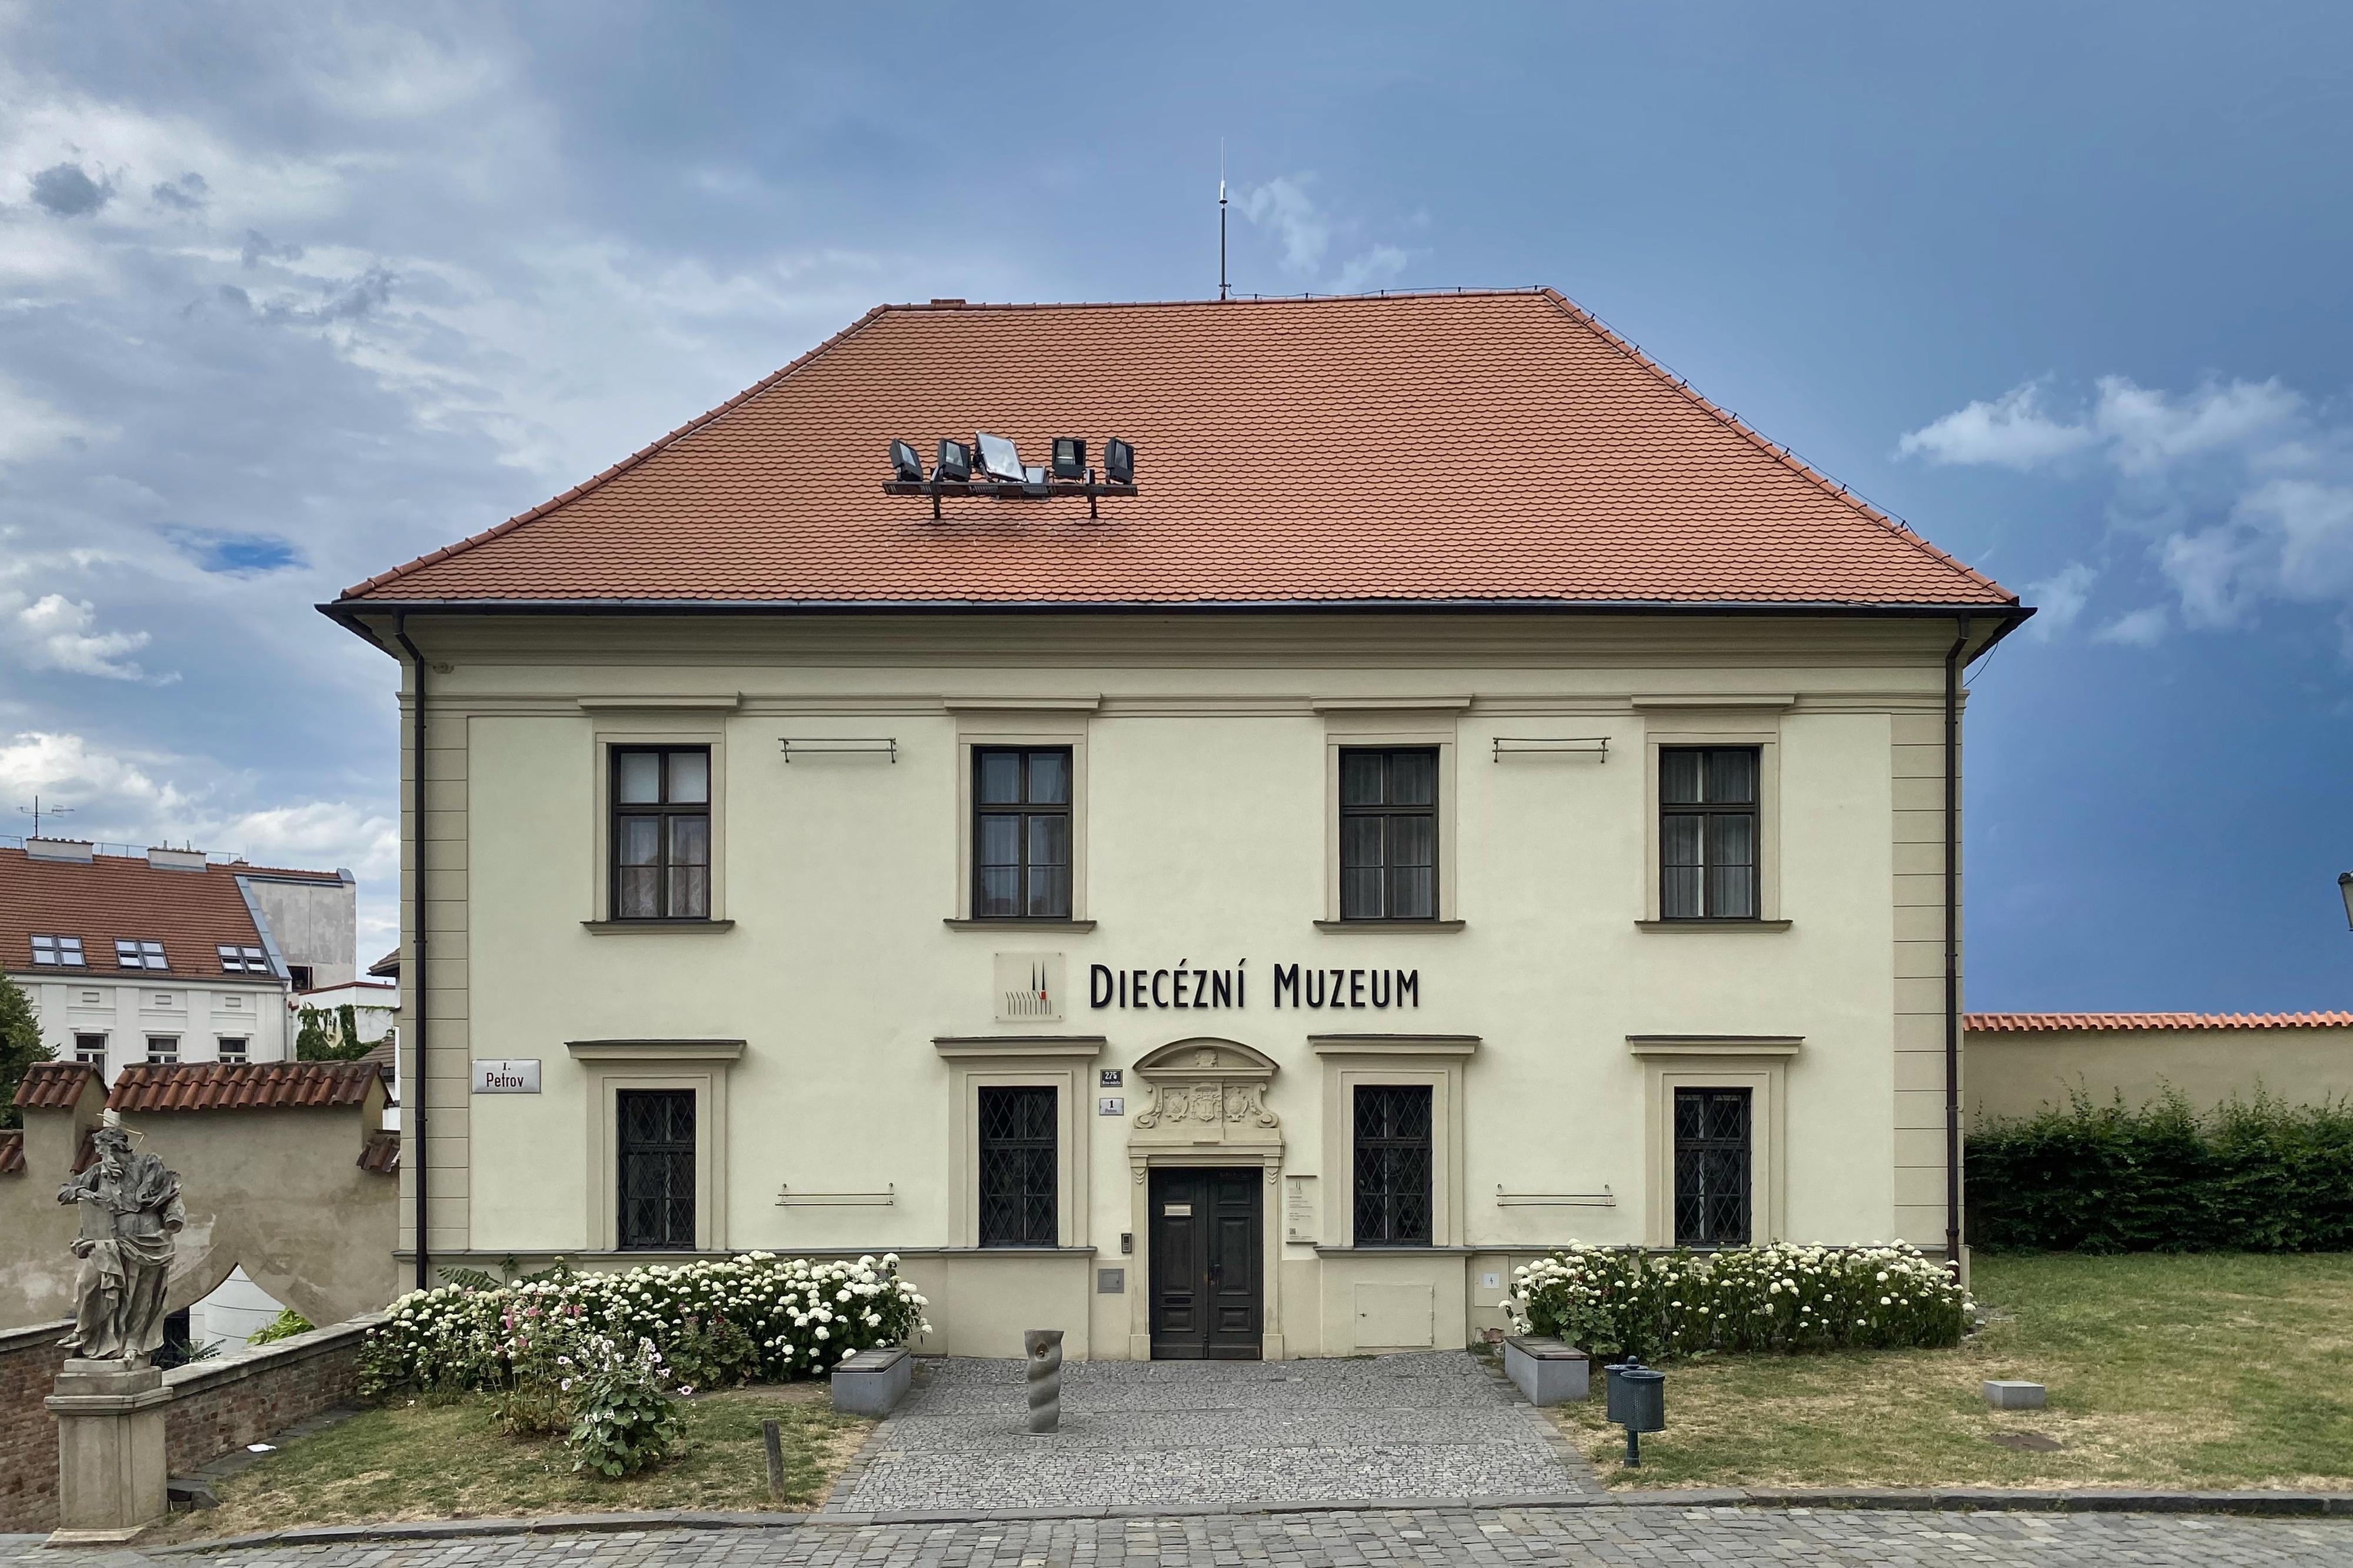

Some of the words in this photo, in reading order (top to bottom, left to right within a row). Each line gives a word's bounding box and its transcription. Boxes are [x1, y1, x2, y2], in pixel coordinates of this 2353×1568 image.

[1274, 963, 1418, 1007] MUZEUM
[486, 1072, 524, 1087] Petrov
[1109, 1100, 1114, 1108] 1
